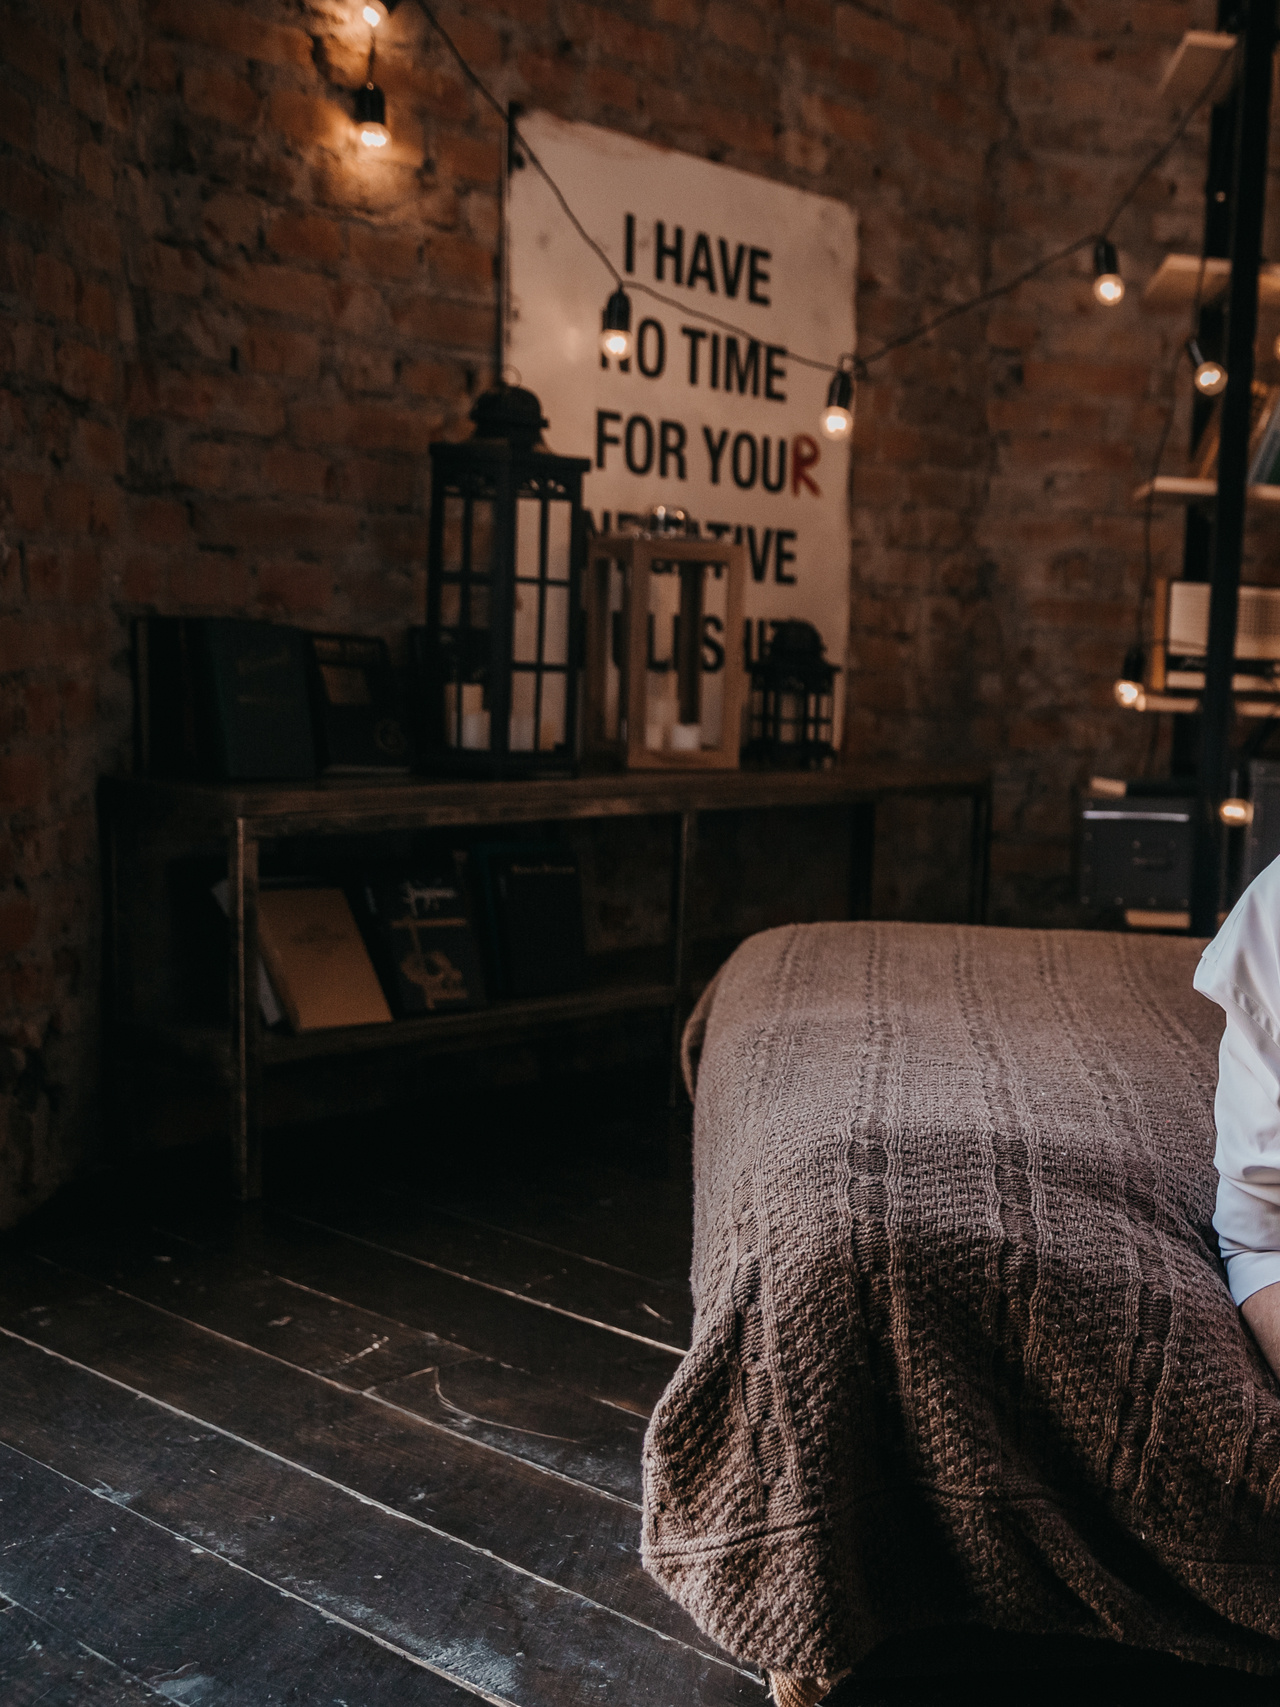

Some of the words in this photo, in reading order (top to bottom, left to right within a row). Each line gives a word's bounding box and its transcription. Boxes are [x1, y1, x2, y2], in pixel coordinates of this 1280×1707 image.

[625, 212, 635, 274] I
[654, 220, 773, 307] HAVE
[681, 324, 788, 402] TIME
[596, 407, 688, 480] FOR
[703, 425, 821, 497] YOUR
